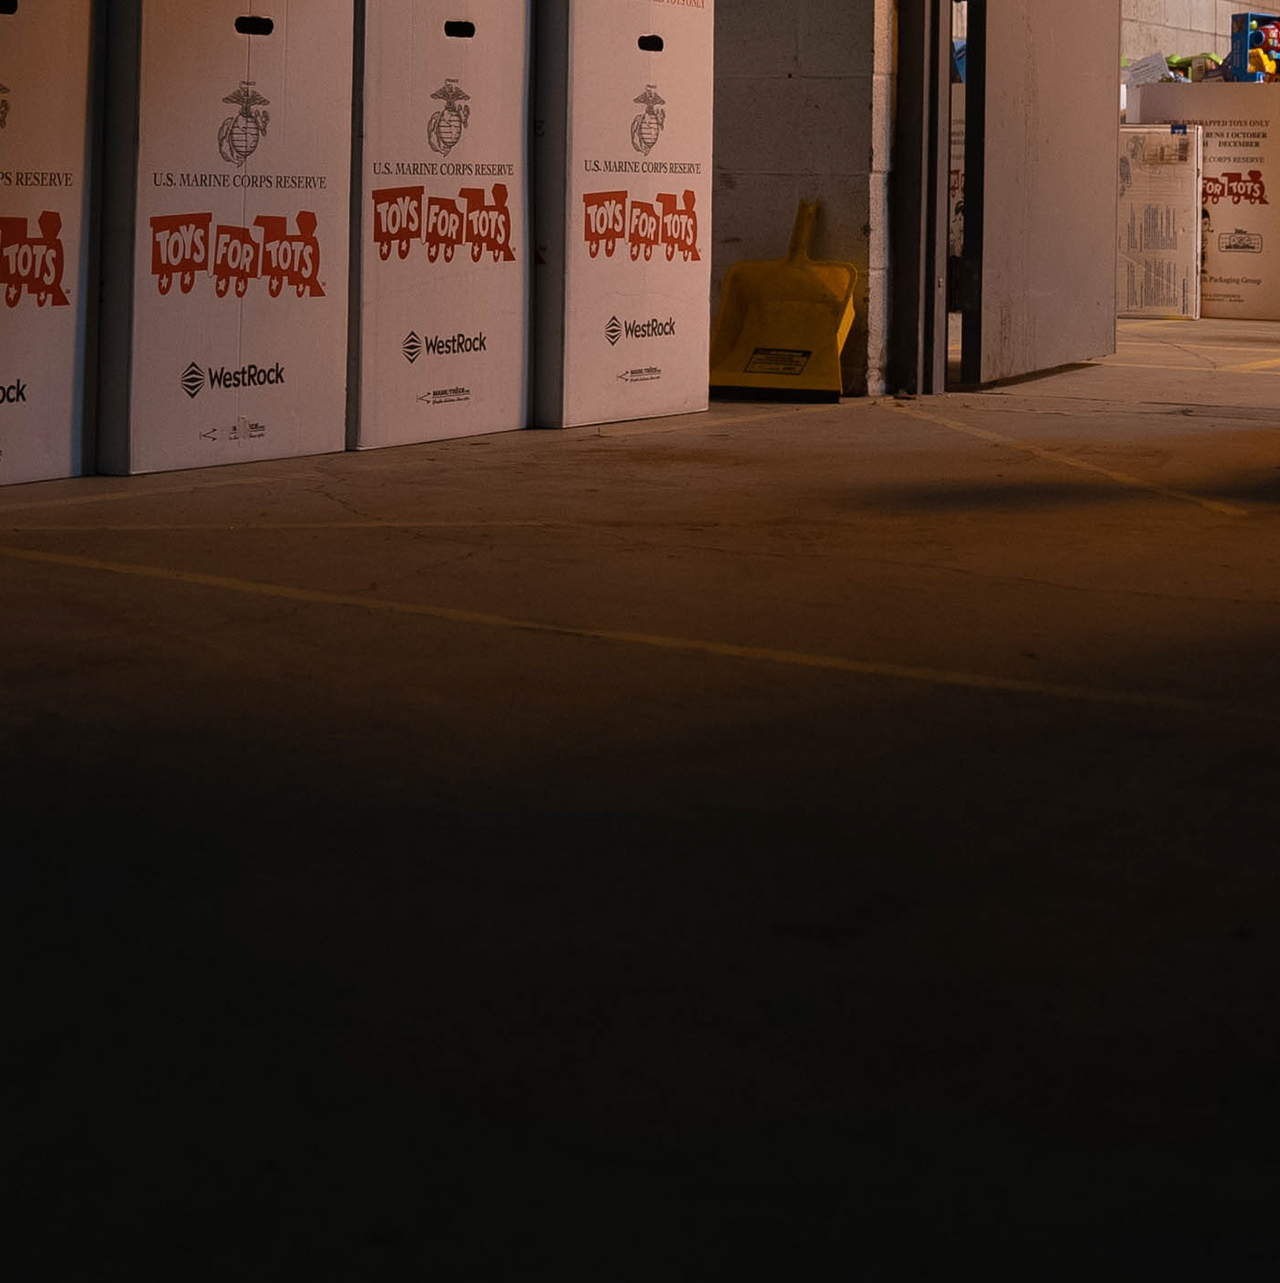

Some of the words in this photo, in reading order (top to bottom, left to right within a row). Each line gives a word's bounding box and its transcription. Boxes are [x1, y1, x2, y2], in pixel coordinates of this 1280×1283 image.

[373, 163, 393, 175] U.S.
[396, 163, 438, 175] MARINE
[440, 163, 473, 175] CORPS
[475, 164, 514, 176] RESERVE
[584, 159, 601, 172] U.S.
[603, 160, 640, 173] MARINE
[641, 162, 668, 174] CORPS
[669, 162, 701, 175] RESERVE
[15, 172, 73, 187] RESERVE
[153, 172, 176, 187] U.S.
[179, 173, 230, 187] MARINE
[233, 174, 273, 188] CORPS
[276, 175, 327, 189] RESERVE
[1229, 182, 1261, 198] TOTS
[376, 196, 419, 234] TOYS
[428, 205, 459, 240] FOR
[469, 210, 505, 245] TOTS
[587, 199, 623, 235] TOYS
[631, 208, 657, 241] FOR
[663, 213, 694, 246] TOTS
[155, 223, 205, 266] TOYS
[216, 234, 254, 272] FOR
[265, 239, 313, 278] TOTS
[4, 244, 56, 285] TOTS
[624, 317, 675, 338] WestRock
[425, 332, 486, 355] WestRock
[208, 363, 285, 389] WestRock
